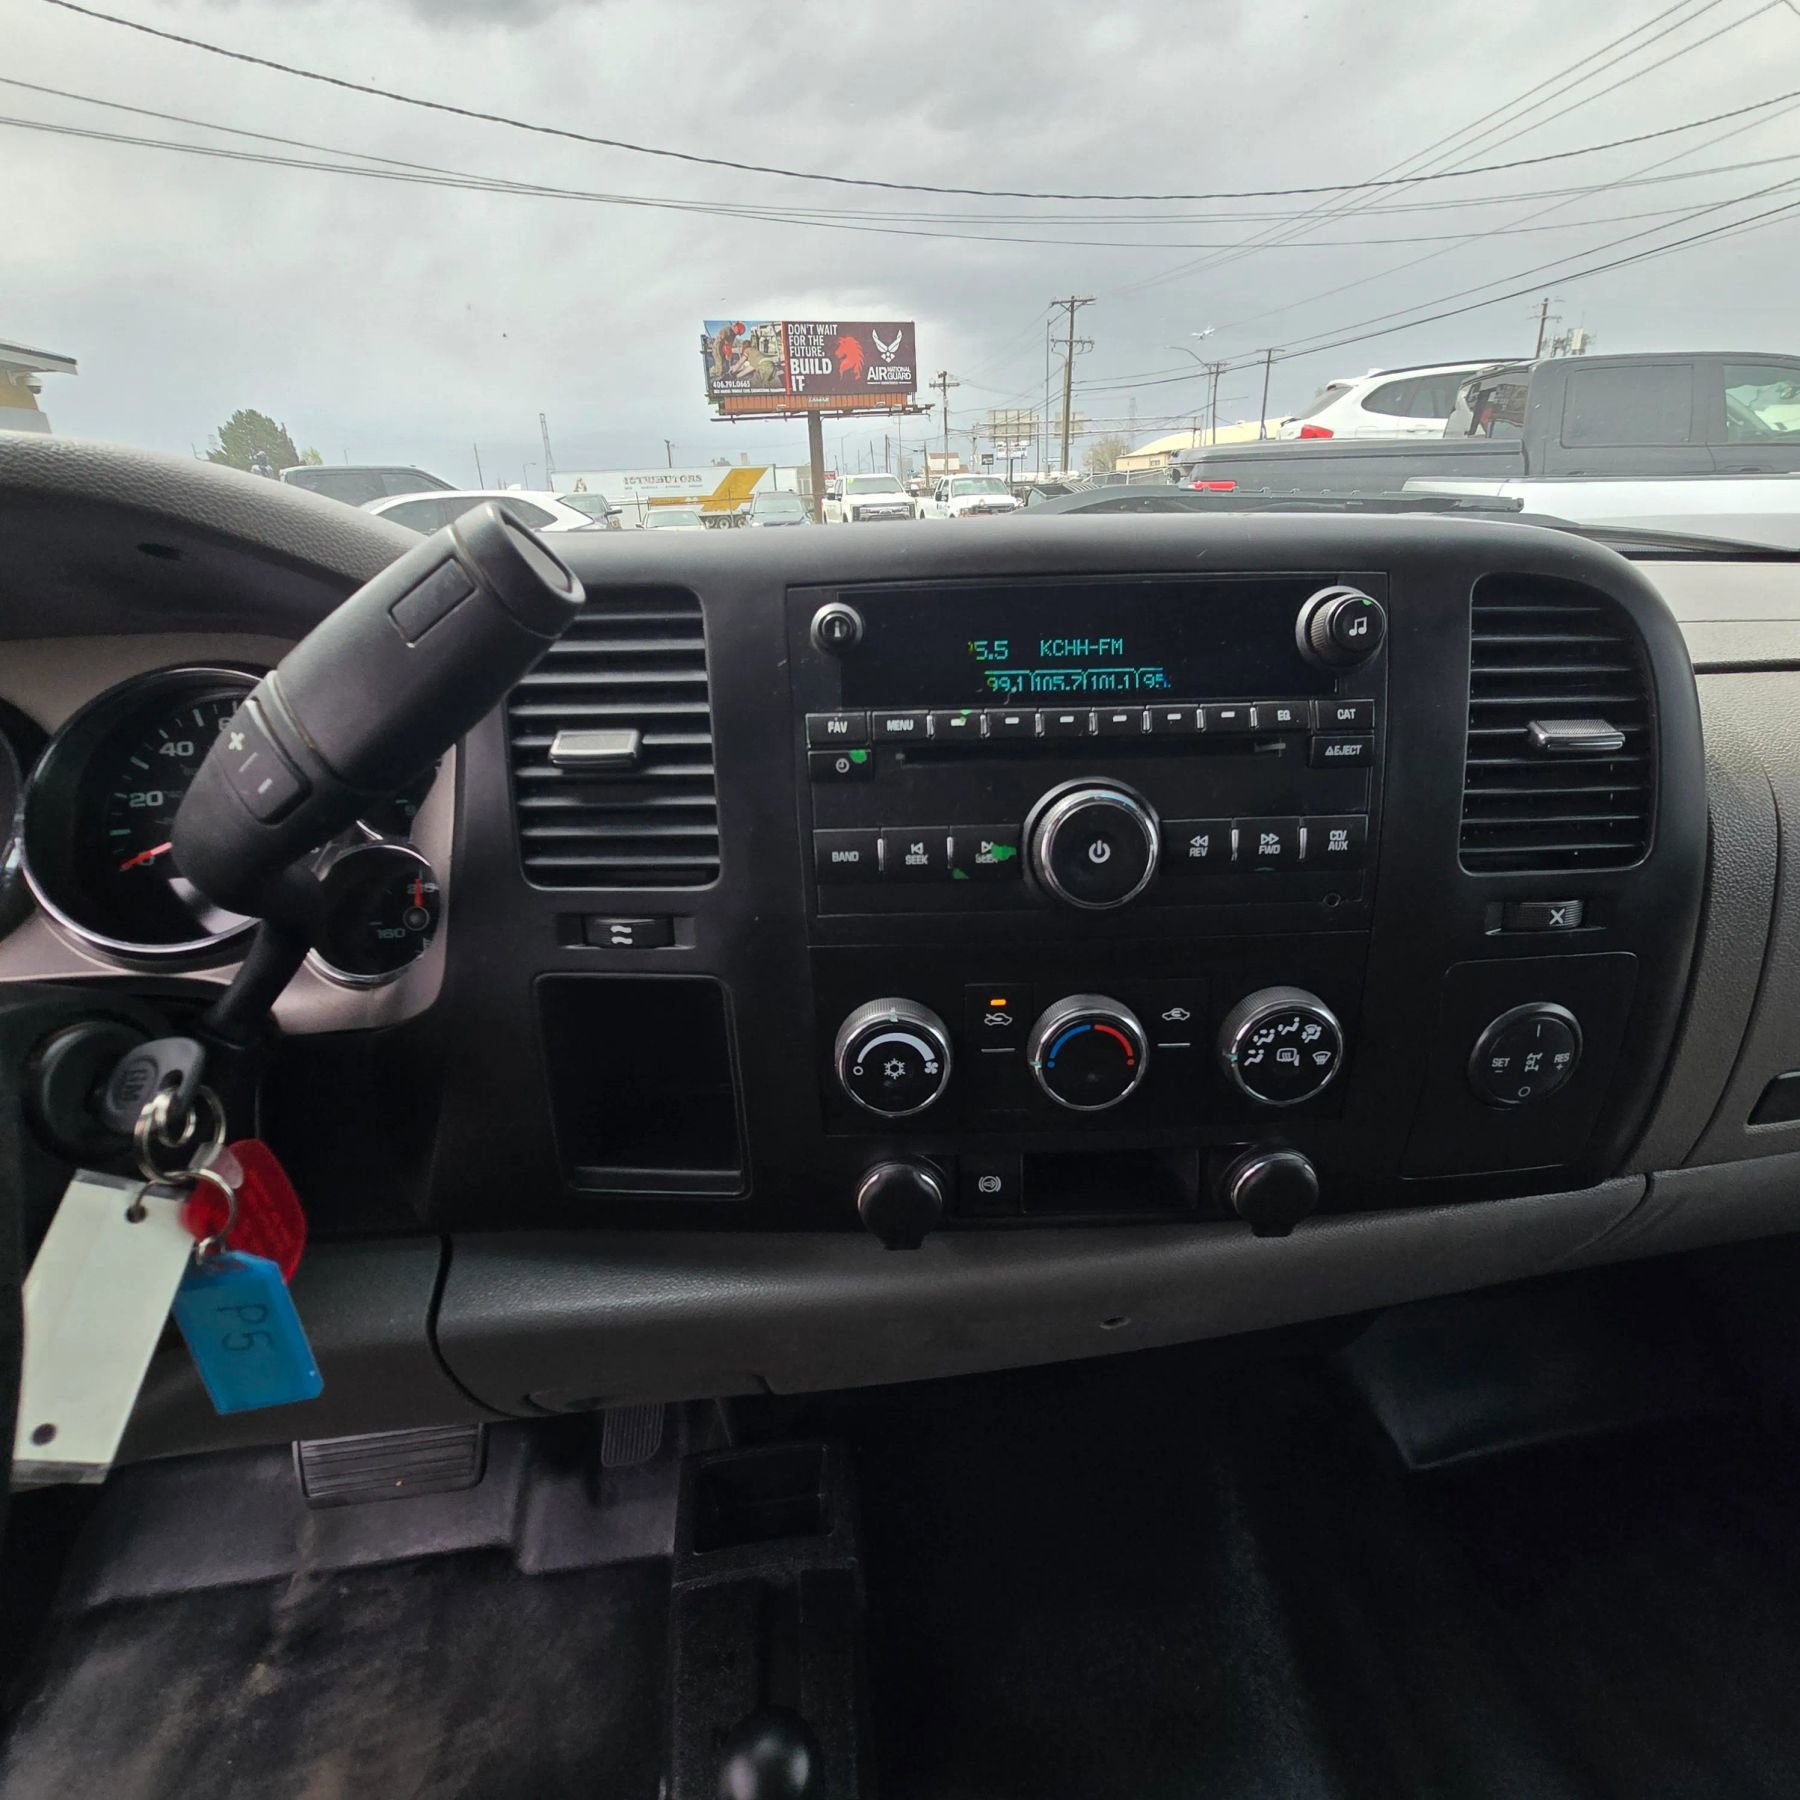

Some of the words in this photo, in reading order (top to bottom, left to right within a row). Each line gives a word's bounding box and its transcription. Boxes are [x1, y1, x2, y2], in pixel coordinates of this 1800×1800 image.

[788, 324, 814, 335] DON'T
[816, 325, 838, 336] WAIT
[789, 335, 807, 346] FOR
[808, 335, 825, 346] THE
[790, 358, 832, 375] BUILD
[867, 366, 888, 380] AIR
[887, 371, 912, 380] GUARD
[1040, 638, 1124, 657] KCHH-FM
[987, 676, 1023, 692] 99.1
[1035, 675, 1082, 691] 105.7
[1091, 674, 1130, 690] 101.1
[1277, 710, 1291, 721] EQ
[1337, 708, 1356, 720] CAT
[827, 721, 848, 733] FAV
[886, 719, 914, 732] MENU
[159, 740, 195, 758] 40
[129, 790, 164, 808] 20
[1329, 829, 1347, 841] CD/
[1189, 847, 1208, 857] REV
[1258, 844, 1281, 855] FWD
[1327, 840, 1349, 852] AUX
[831, 851, 860, 863] BAND
[905, 854, 929, 865] SEEK
[376, 927, 406, 940] 160
[1491, 1057, 1510, 1068] SET
[1554, 1052, 1571, 1064] RES
[215, 1303, 279, 1352] P5
